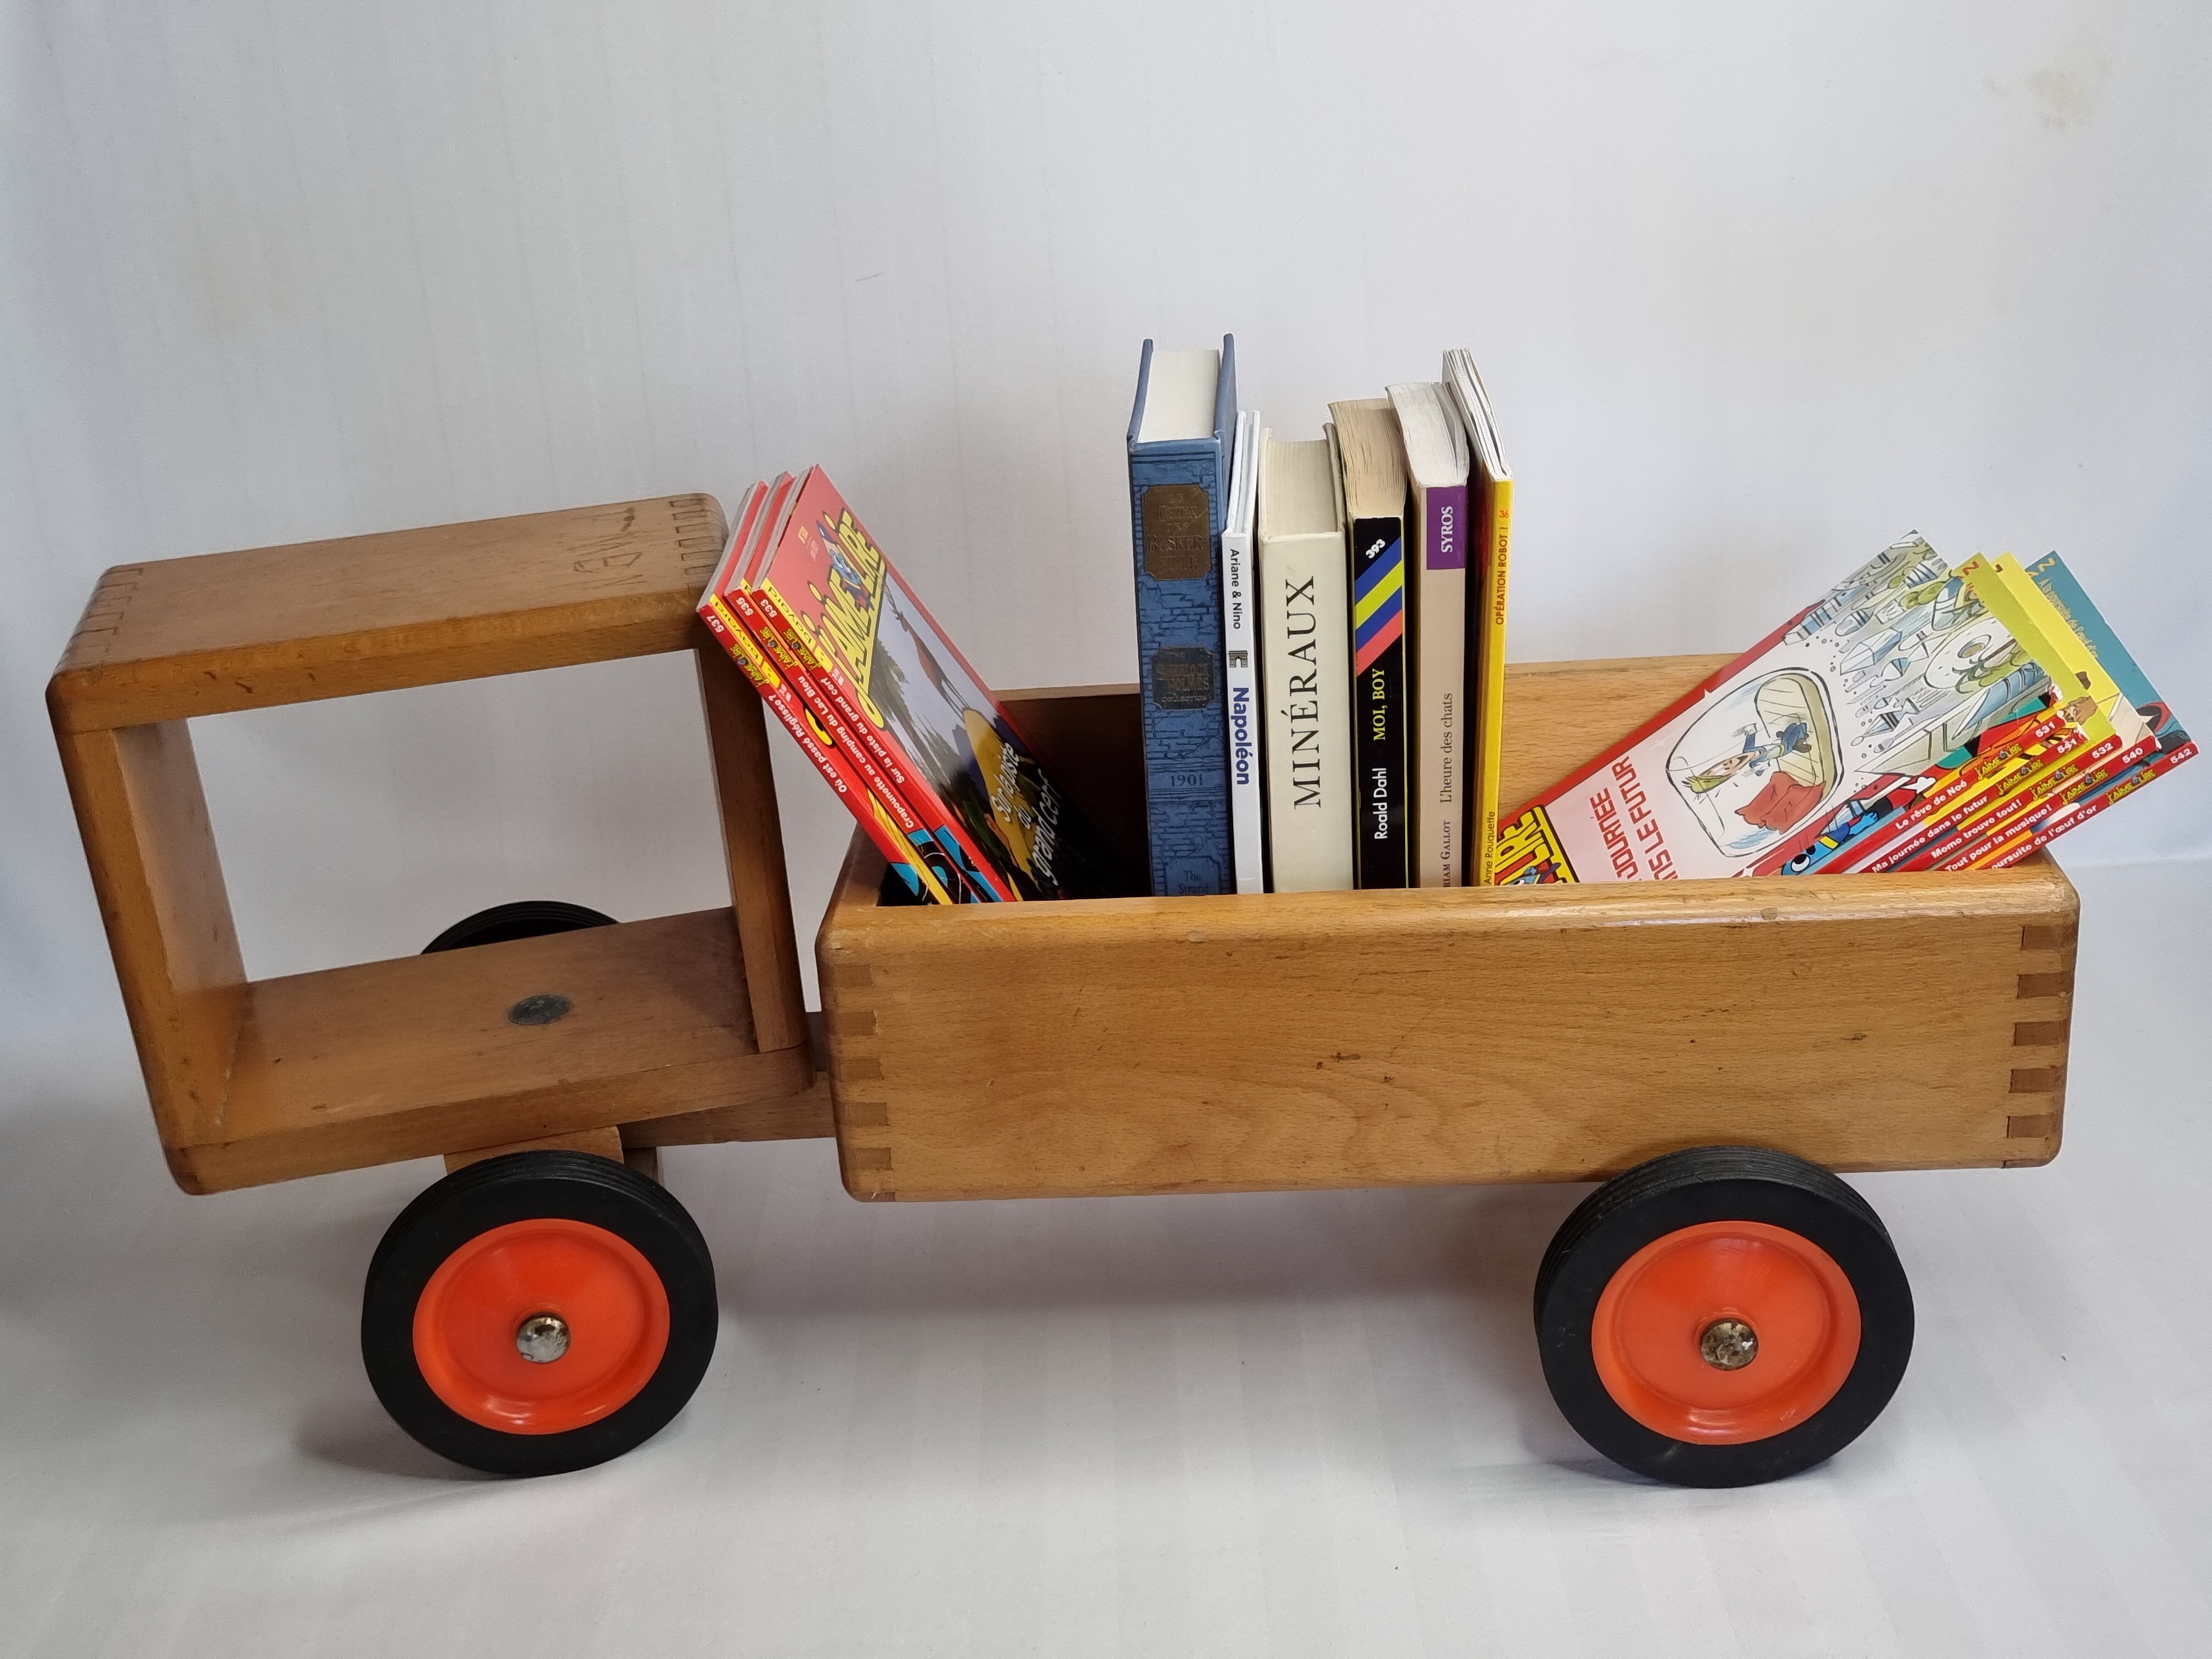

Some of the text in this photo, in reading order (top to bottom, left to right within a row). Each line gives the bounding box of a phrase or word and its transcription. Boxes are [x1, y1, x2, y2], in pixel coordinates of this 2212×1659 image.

[1499, 510, 1509, 518] 36
[1441, 506, 1453, 552] SYROS
[1365, 539, 1386, 559] 393
[1230, 548, 1240, 587] Ariane
[736, 597, 753, 616] 535
[760, 599, 777, 618] 533
[1494, 571, 1506, 625] OPÉRATION
[707, 615, 724, 633] 537
[768, 586, 812, 644] bayard
[1232, 602, 1243, 629] Nino
[715, 602, 759, 659] bayard
[821, 677, 838, 695] cerf
[1280, 575, 1321, 809] MINÉRAUX
[835, 696, 859, 721] grand
[1372, 668, 1387, 741] MOI, BOY
[856, 722, 868, 734] du
[1231, 687, 1254, 785] Napoléon
[2035, 721, 2056, 737] 531
[798, 676, 914, 828] Crapounette au camping du Lac Bleu
[802, 737, 827, 763] passé
[866, 735, 887, 756] piste
[1440, 692, 1453, 803] L'heure des chats
[2057, 738, 2078, 753] 541
[2092, 742, 2113, 759] 532
[2122, 748, 2143, 763] 540
[2170, 748, 2192, 764] 542
[823, 763, 837, 778] est
[884, 757, 893, 768] la
[835, 778, 847, 793] Où
[890, 768, 905, 784] Sur
[991, 742, 1021, 822] Sur la piste
[1171, 774, 1203, 786] 1901
[1612, 755, 1651, 824] FUTUR
[1373, 768, 1387, 839] Roald Dahl
[1895, 780, 1967, 830] Le rêve de Noé
[1014, 805, 1032, 830] du
[1031, 768, 1062, 886] grand cerf
[1441, 820, 1451, 860] GALLOT
[1484, 811, 1495, 884] Anne Rouquette
[1637, 819, 1664, 854] LE
[1872, 796, 1988, 873] Ma journée dans le futur
[1931, 838, 1962, 859] Momo
[1963, 817, 1995, 838] trouve
[1991, 845, 2032, 870] oursuite
[2034, 836, 2047, 845] de
[2076, 805, 2097, 820] d'or
[1945, 856, 1968, 872] Tout
[1969, 842, 1992, 860] pour
[1993, 835, 2005, 844] la
[1179, 883, 1209, 894] Strand
[1184, 870, 1201, 882] The
